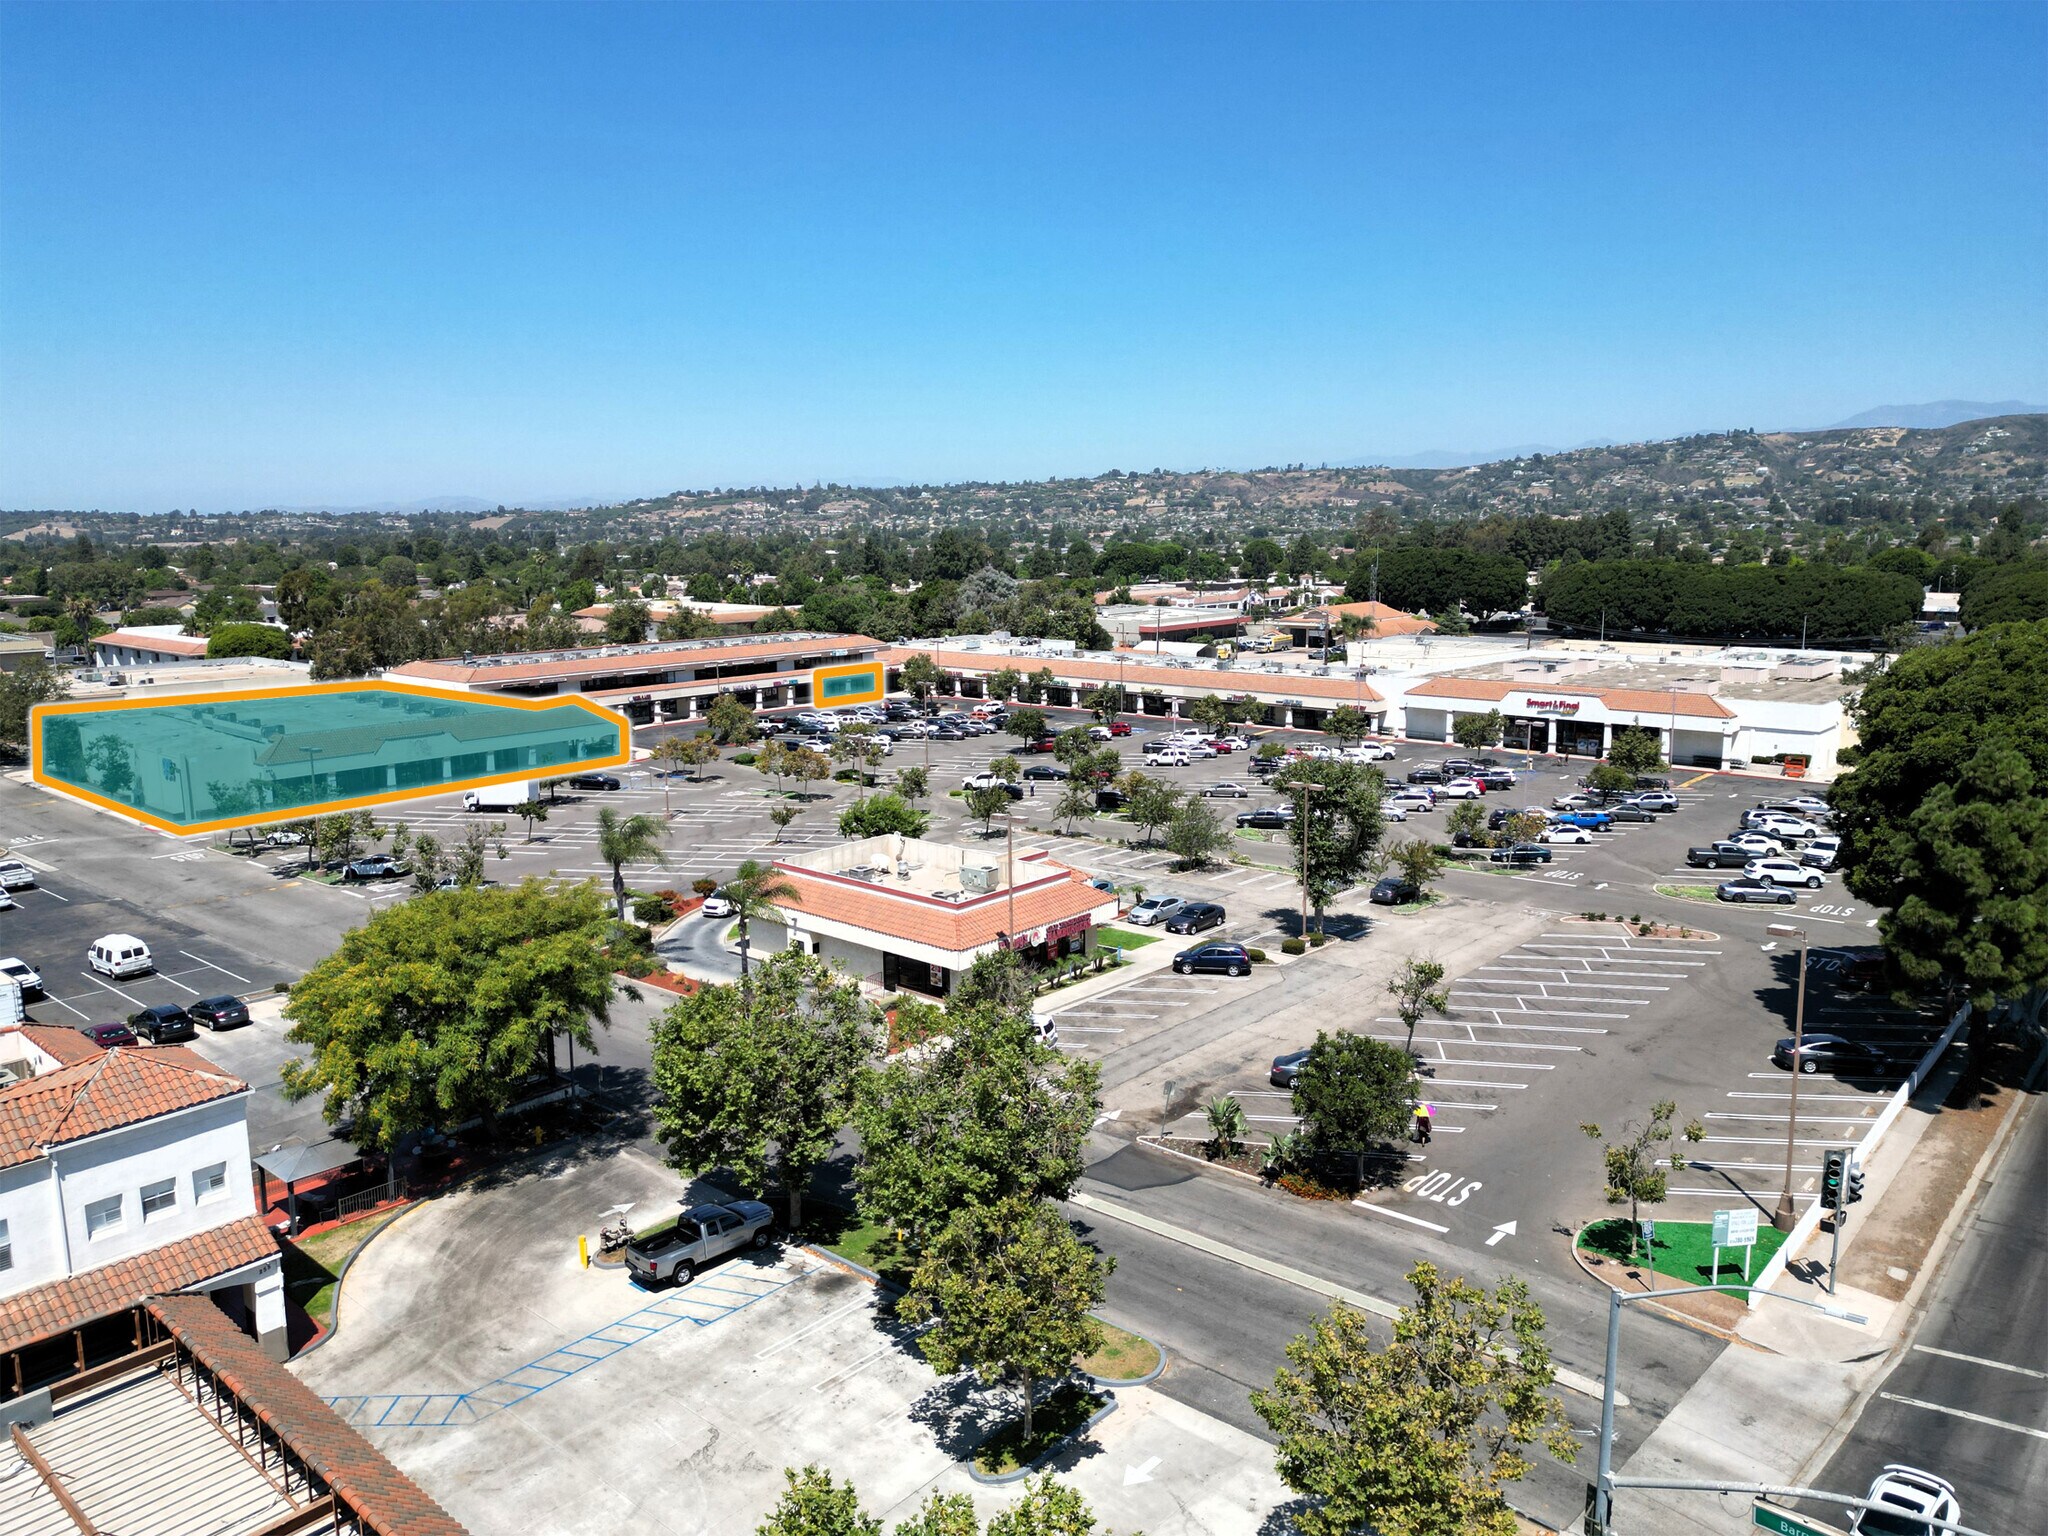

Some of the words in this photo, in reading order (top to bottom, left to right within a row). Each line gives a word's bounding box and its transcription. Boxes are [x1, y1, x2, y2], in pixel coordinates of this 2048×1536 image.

[1526, 698, 1552, 709] Smart
[1559, 700, 1580, 710] Final
[1543, 869, 1585, 880] STOP
[1809, 904, 1856, 917] STOP
[1806, 956, 1842, 971] STO
[1402, 1169, 1483, 1206] STOP
